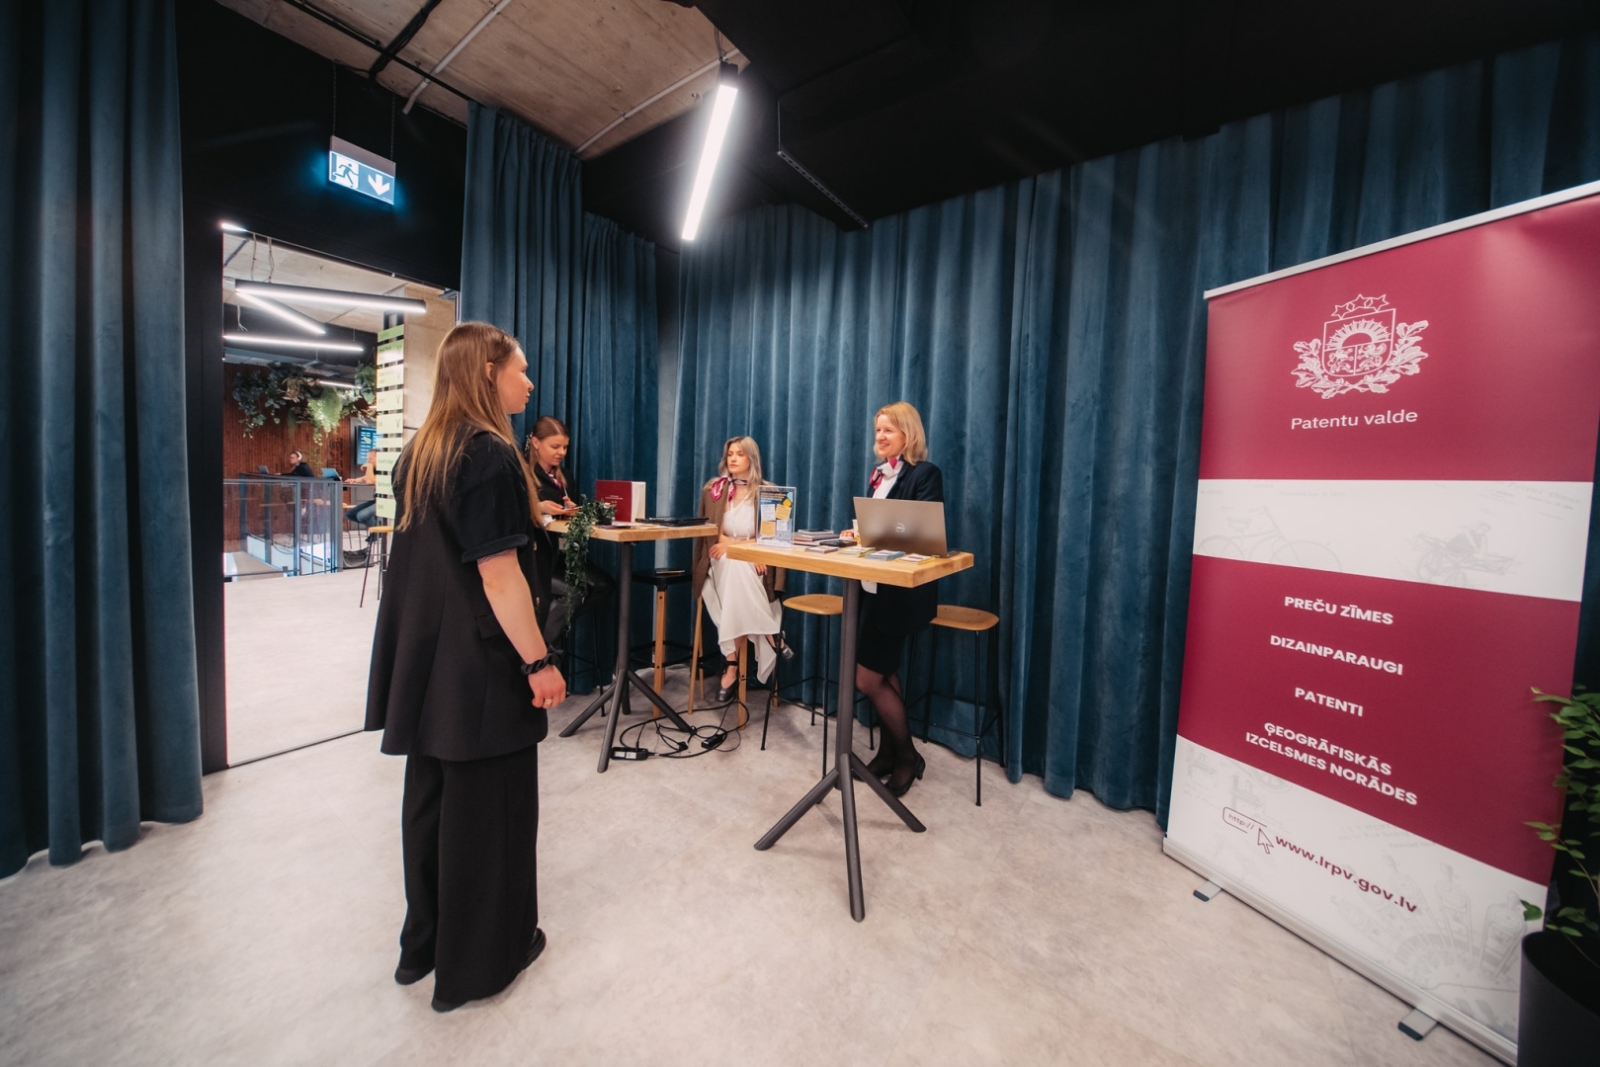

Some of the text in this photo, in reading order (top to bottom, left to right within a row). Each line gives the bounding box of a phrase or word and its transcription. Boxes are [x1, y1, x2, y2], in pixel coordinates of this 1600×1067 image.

[1291, 409, 1418, 430] Patentu valde
[1284, 596, 1394, 625] PREČU ZĪMES
[1270, 634, 1403, 675] DIZAINPARAUGI
[1294, 687, 1363, 717] PATENTI
[1264, 722, 1392, 776] ĢEOGRĀFISKĀS
[1245, 732, 1418, 806] IZCELSMES NORĀDES
[1228, 813, 1255, 831] http://
[1275, 835, 1417, 913] www.lrpv.gov.lv
